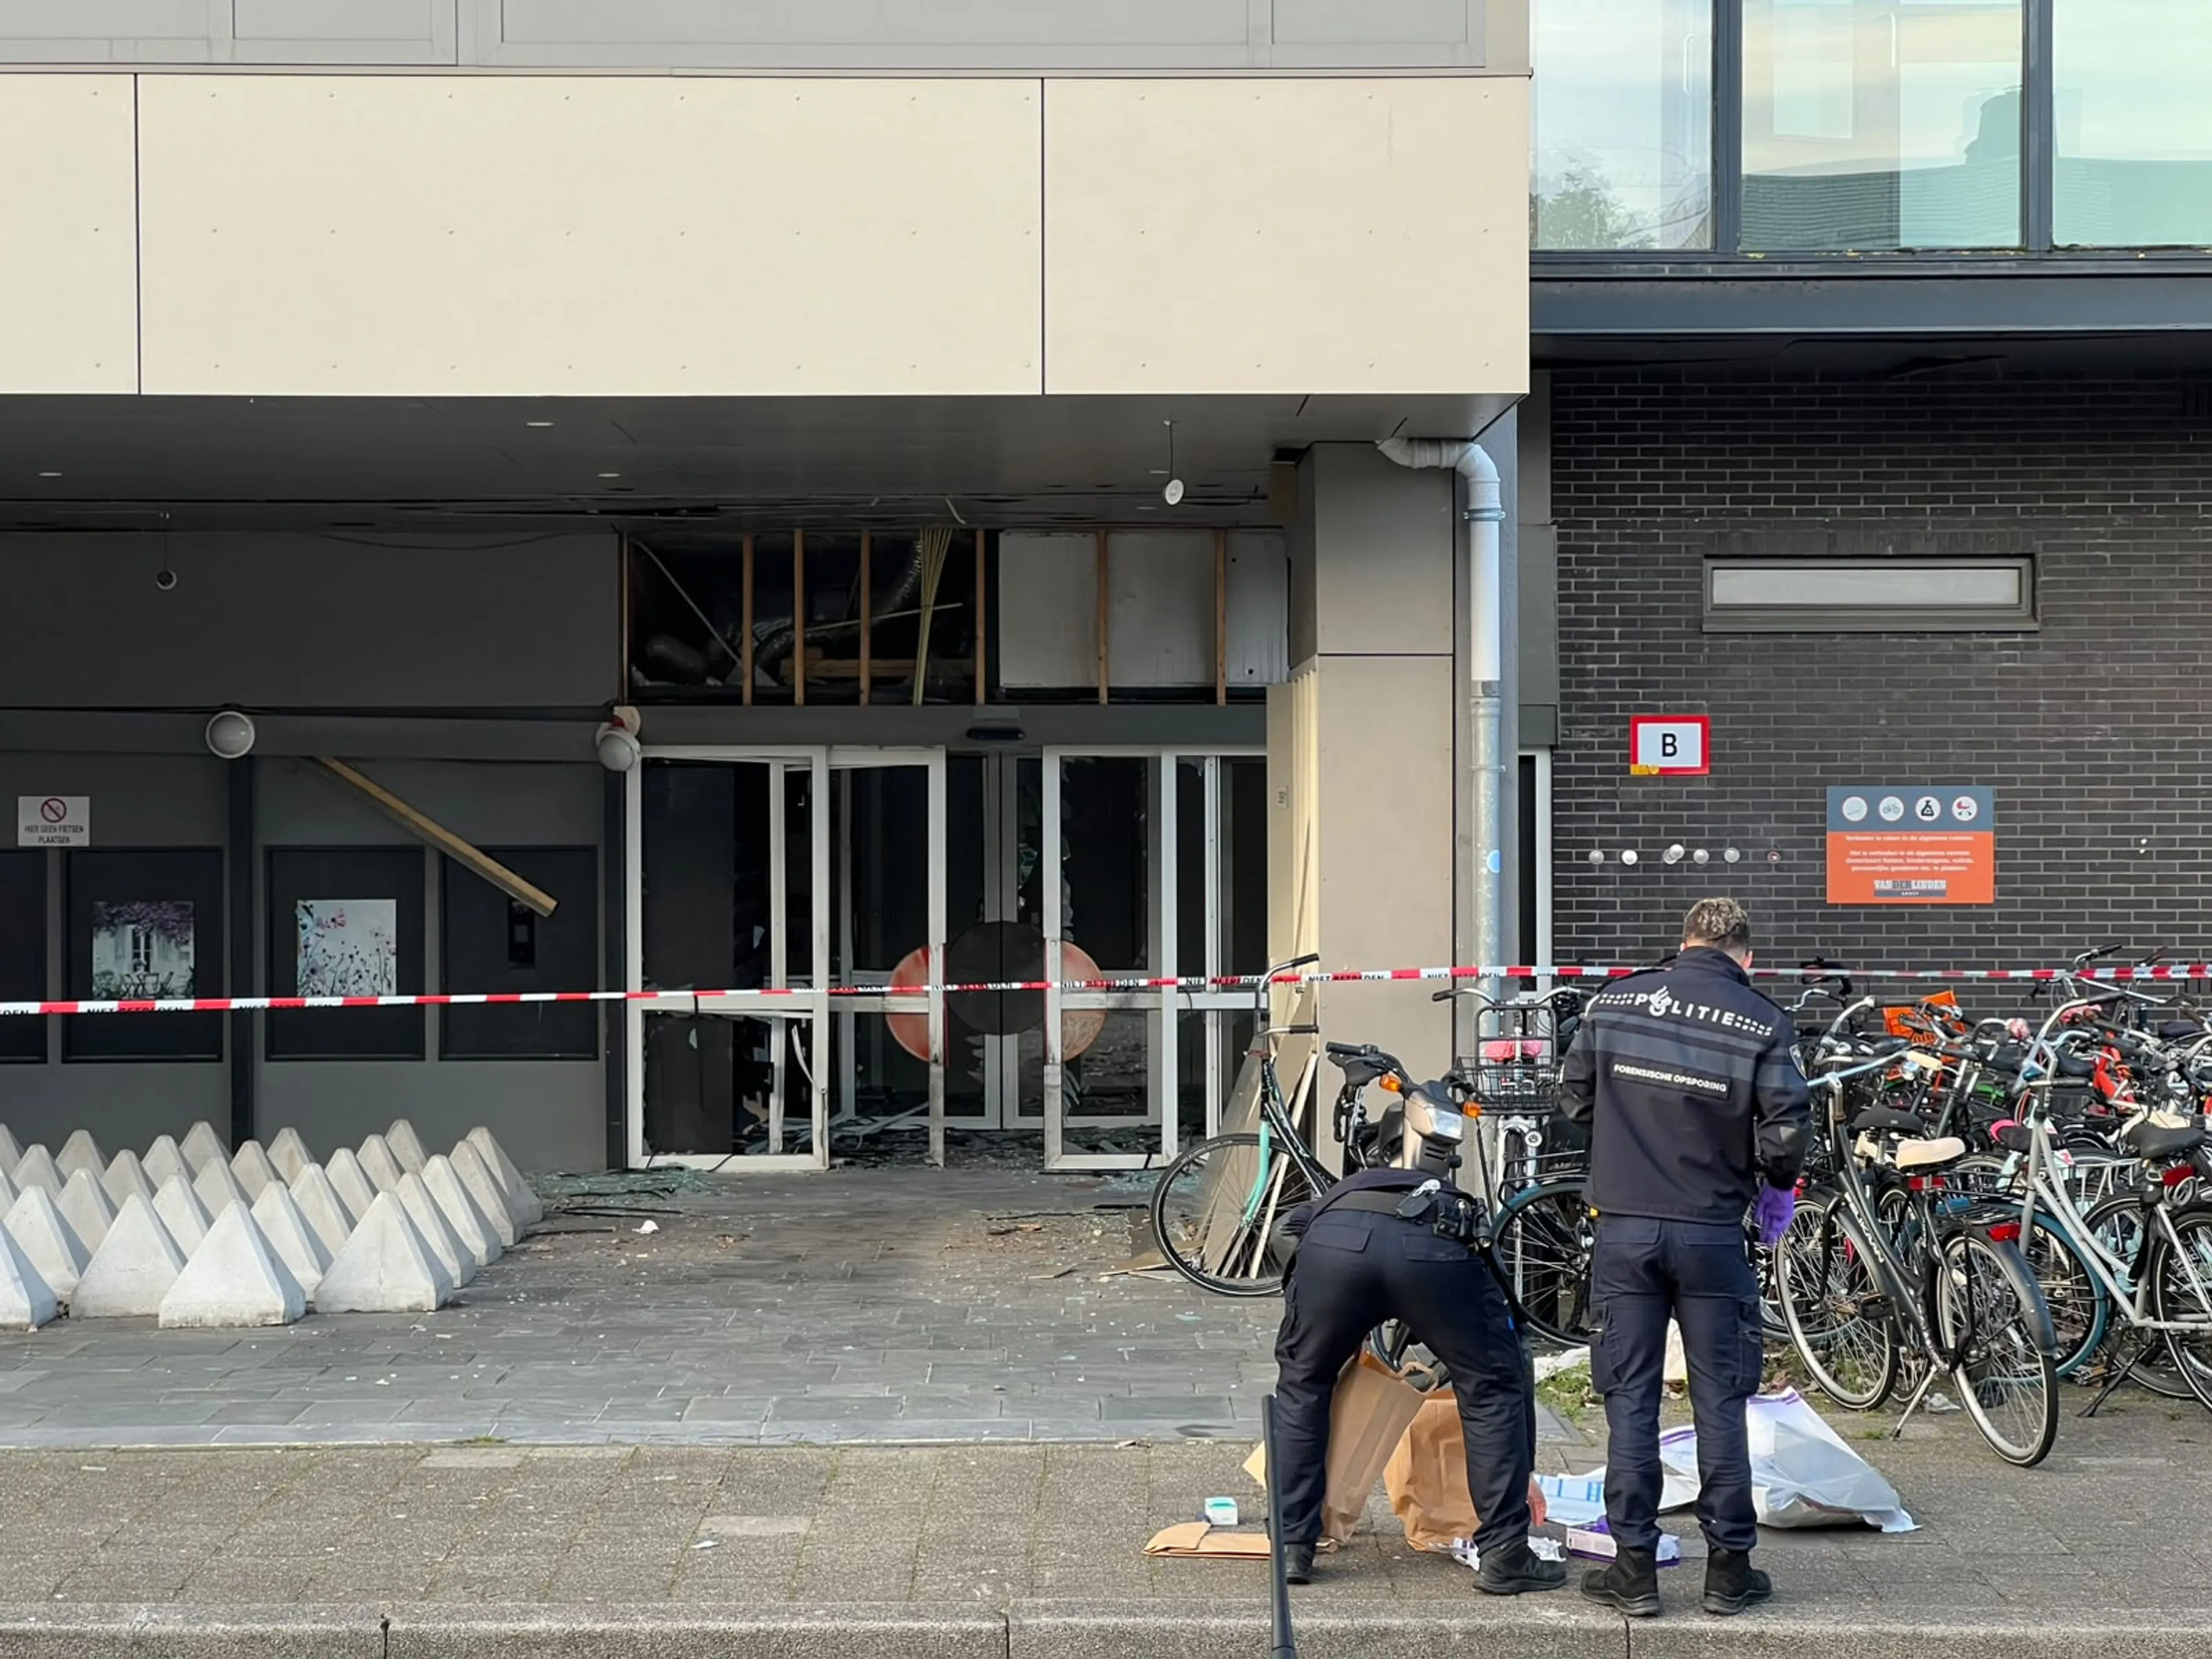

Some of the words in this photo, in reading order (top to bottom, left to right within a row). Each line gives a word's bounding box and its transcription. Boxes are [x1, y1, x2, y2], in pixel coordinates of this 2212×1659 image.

[1662, 733, 1677, 757] B
[1634, 987, 1735, 1026] POLITIE
[1614, 1064, 1672, 1082] FORENSISCHE
[1673, 1073, 1727, 1093] OPSPORING
